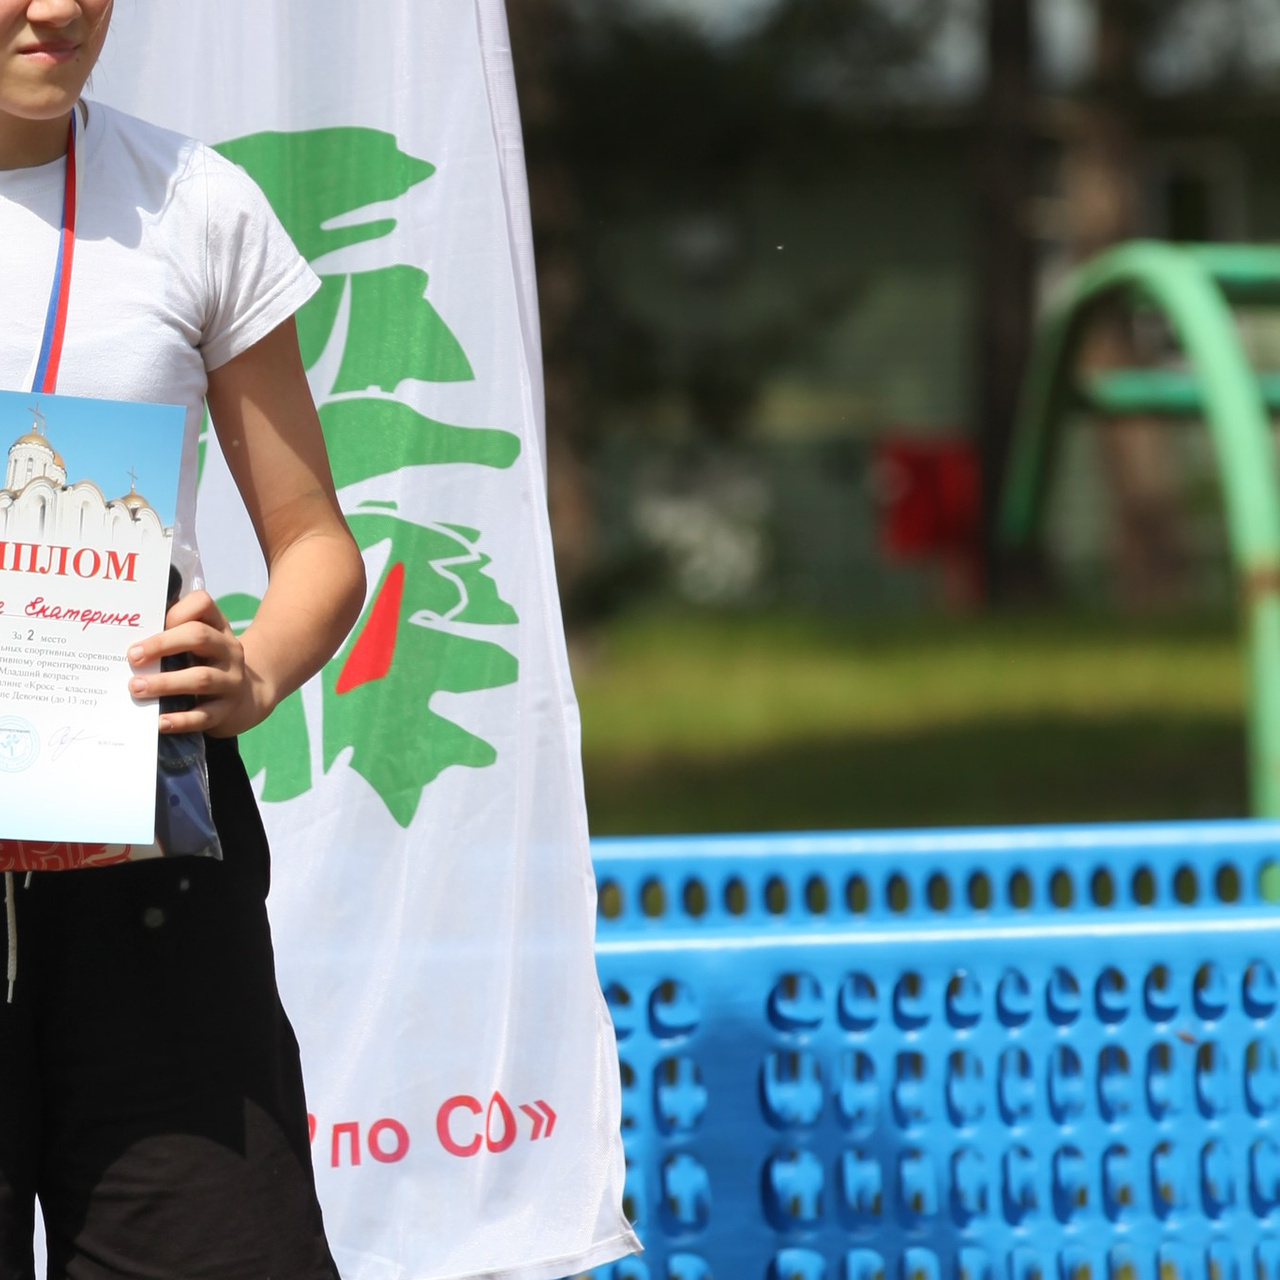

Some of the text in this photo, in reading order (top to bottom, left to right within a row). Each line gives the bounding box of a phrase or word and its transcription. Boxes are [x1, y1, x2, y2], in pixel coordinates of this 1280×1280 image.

[25, 596, 140, 631] Екатерине
[11, 629, 67, 644] За 2 место
[24, 647, 76, 658] спортивных
[78, 652, 127, 662] соревнован
[36, 659, 109, 672] ориентированию
[42, 671, 80, 681] возраст»
[24, 681, 55, 691] «Кросс
[65, 685, 108, 695] классика»
[11, 691, 49, 702] Девочки
[50, 695, 65, 704] (до
[68, 696, 77, 704] 13
[331, 1117, 410, 1168] по
